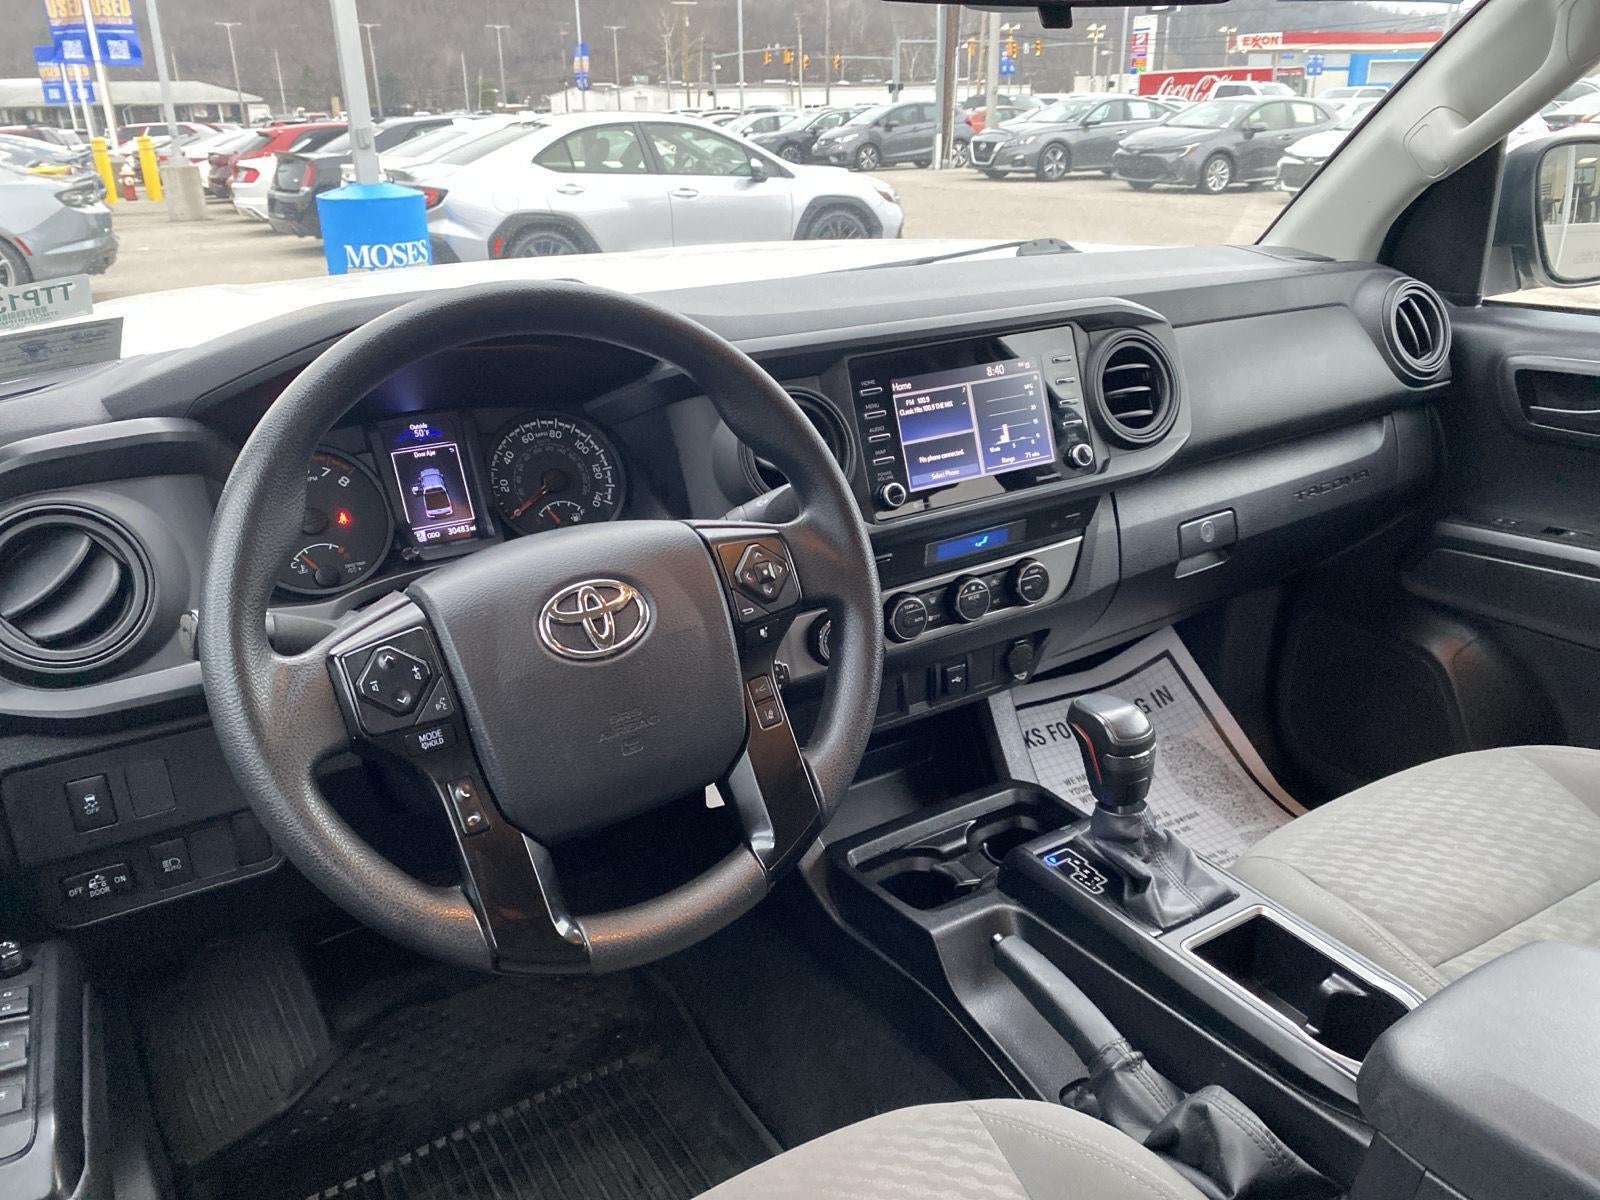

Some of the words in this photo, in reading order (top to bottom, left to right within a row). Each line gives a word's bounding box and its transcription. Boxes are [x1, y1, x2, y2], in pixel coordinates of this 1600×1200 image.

[91, 0, 131, 17] USED
[1242, 35, 1279, 48] EXXON
[343, 239, 429, 269] MOSES
[987, 364, 1005, 377] 8:40
[892, 382, 912, 392] Home
[521, 432, 535, 444] 60
[549, 429, 562, 439] 80
[574, 439, 590, 455] 100
[503, 450, 514, 465] 40
[321, 466, 331, 477] 7
[592, 463, 603, 480] 120
[338, 476, 350, 487] 8
[499, 479, 510, 493] 20
[592, 491, 603, 508] 140
[427, 531, 440, 539] ODO
[447, 524, 470, 535] 30483
[1150, 685, 1175, 708] IN
[419, 729, 443, 742] MODE
[427, 737, 444, 748] HOLD
[86, 807, 99, 815] OFF
[164, 864, 182, 873] AUTO
[114, 875, 126, 883] ON
[69, 887, 83, 897] OFF
[89, 886, 110, 898] DOOR
